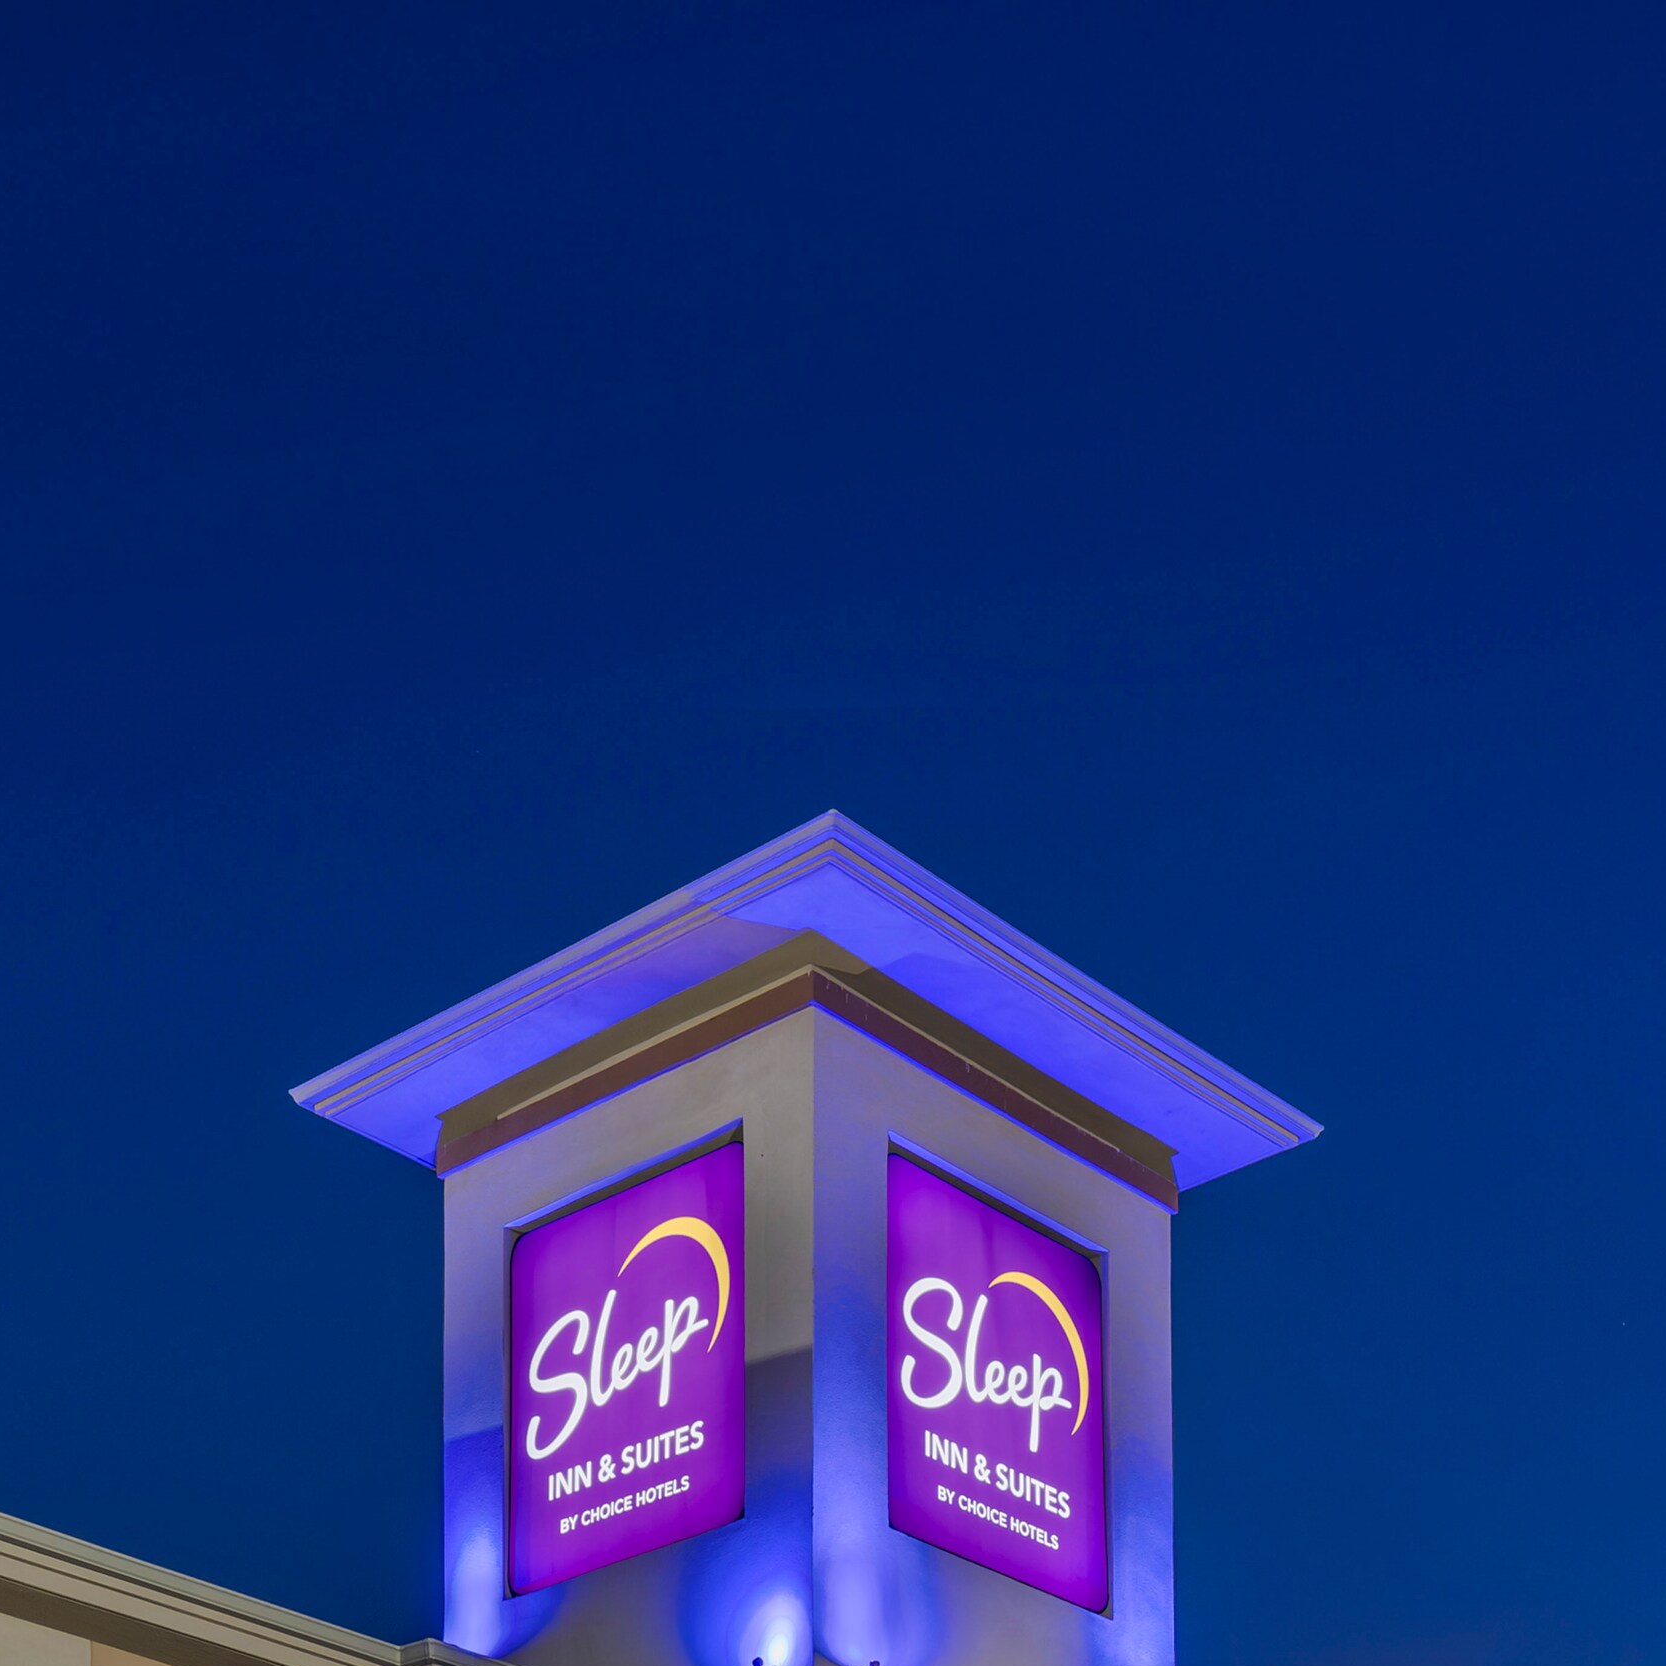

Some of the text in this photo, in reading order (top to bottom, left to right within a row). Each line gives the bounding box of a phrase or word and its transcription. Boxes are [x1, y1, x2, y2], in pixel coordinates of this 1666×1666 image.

[525, 1289, 710, 1460] Sleep
[900, 1276, 1073, 1453] Sleep
[547, 1420, 705, 1502] INN & SUITES
[924, 1429, 1071, 1520] INN & SUITES
[559, 1474, 690, 1535] BY CHOICE HOTELS
[936, 1484, 1059, 1551] BY CHOICE HOTELS
